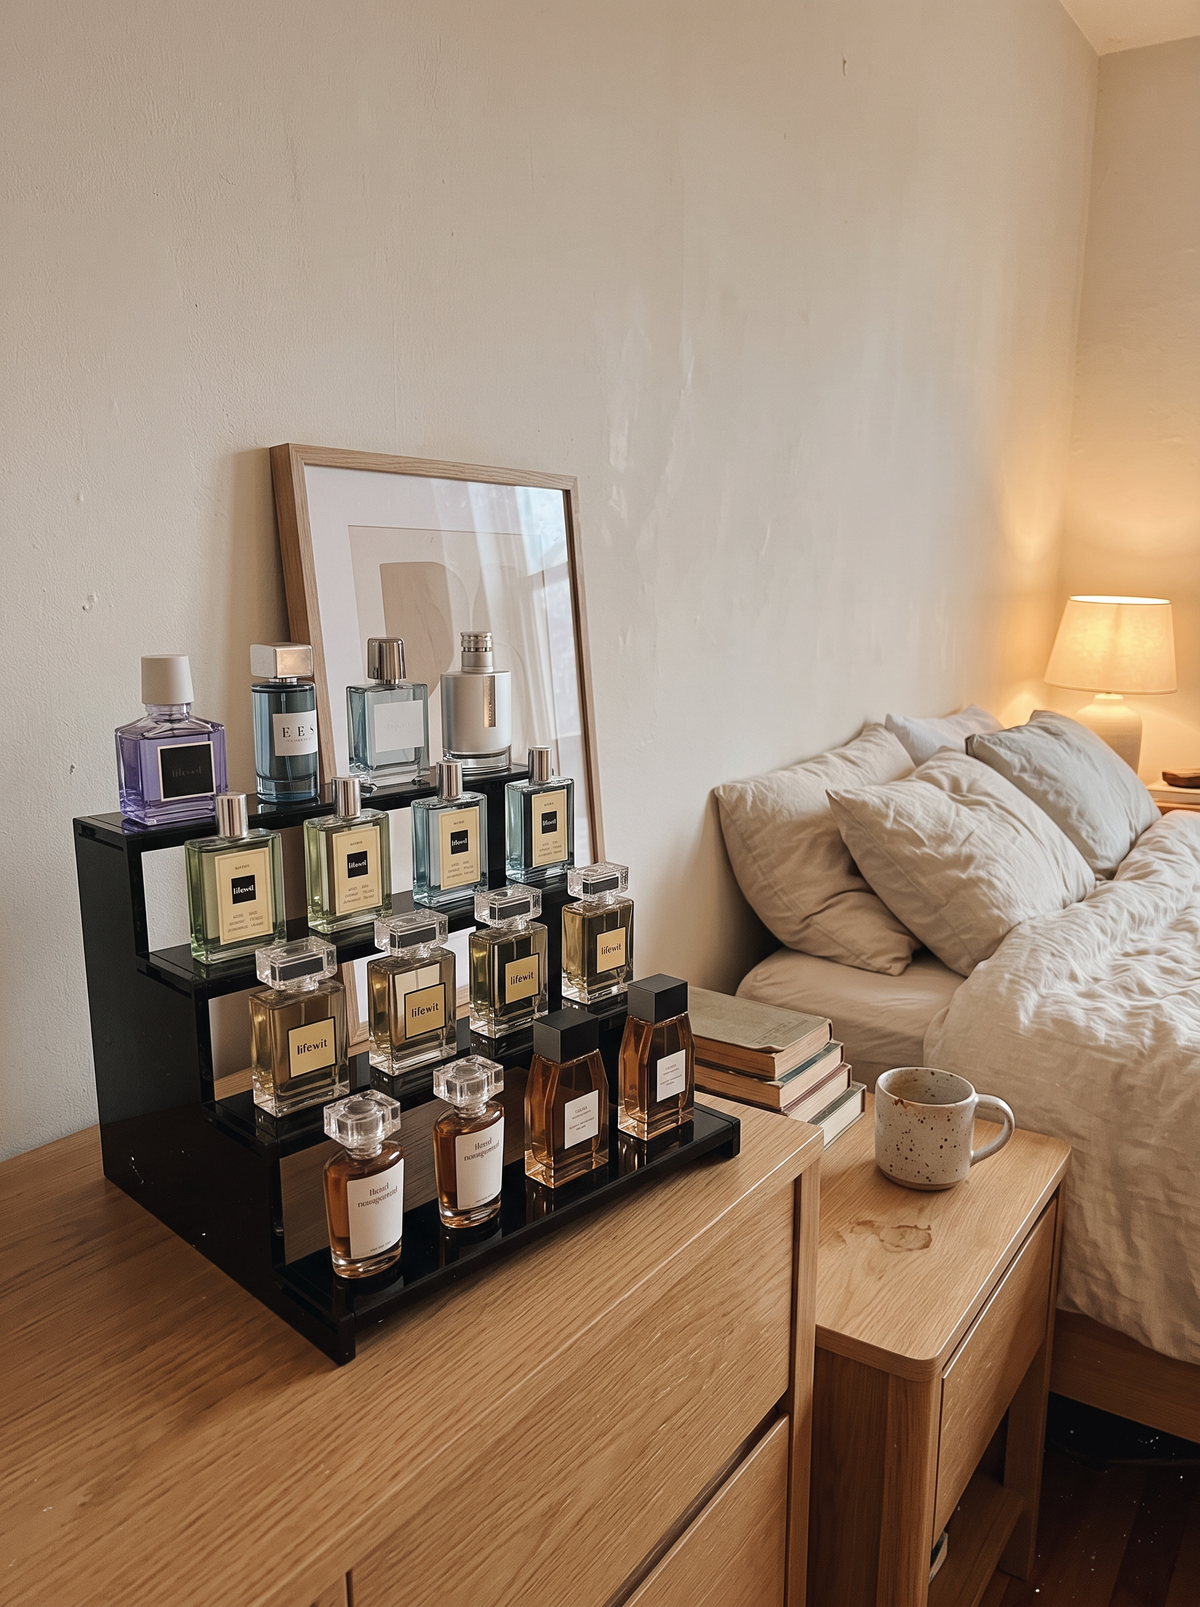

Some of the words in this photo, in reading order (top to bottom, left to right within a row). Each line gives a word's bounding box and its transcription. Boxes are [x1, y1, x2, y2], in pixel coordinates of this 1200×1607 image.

[601, 943, 622, 955] lifewit
[510, 971, 534, 985] lifewit
[411, 1002, 439, 1018] lifewit
[297, 1039, 328, 1055] lifewit
